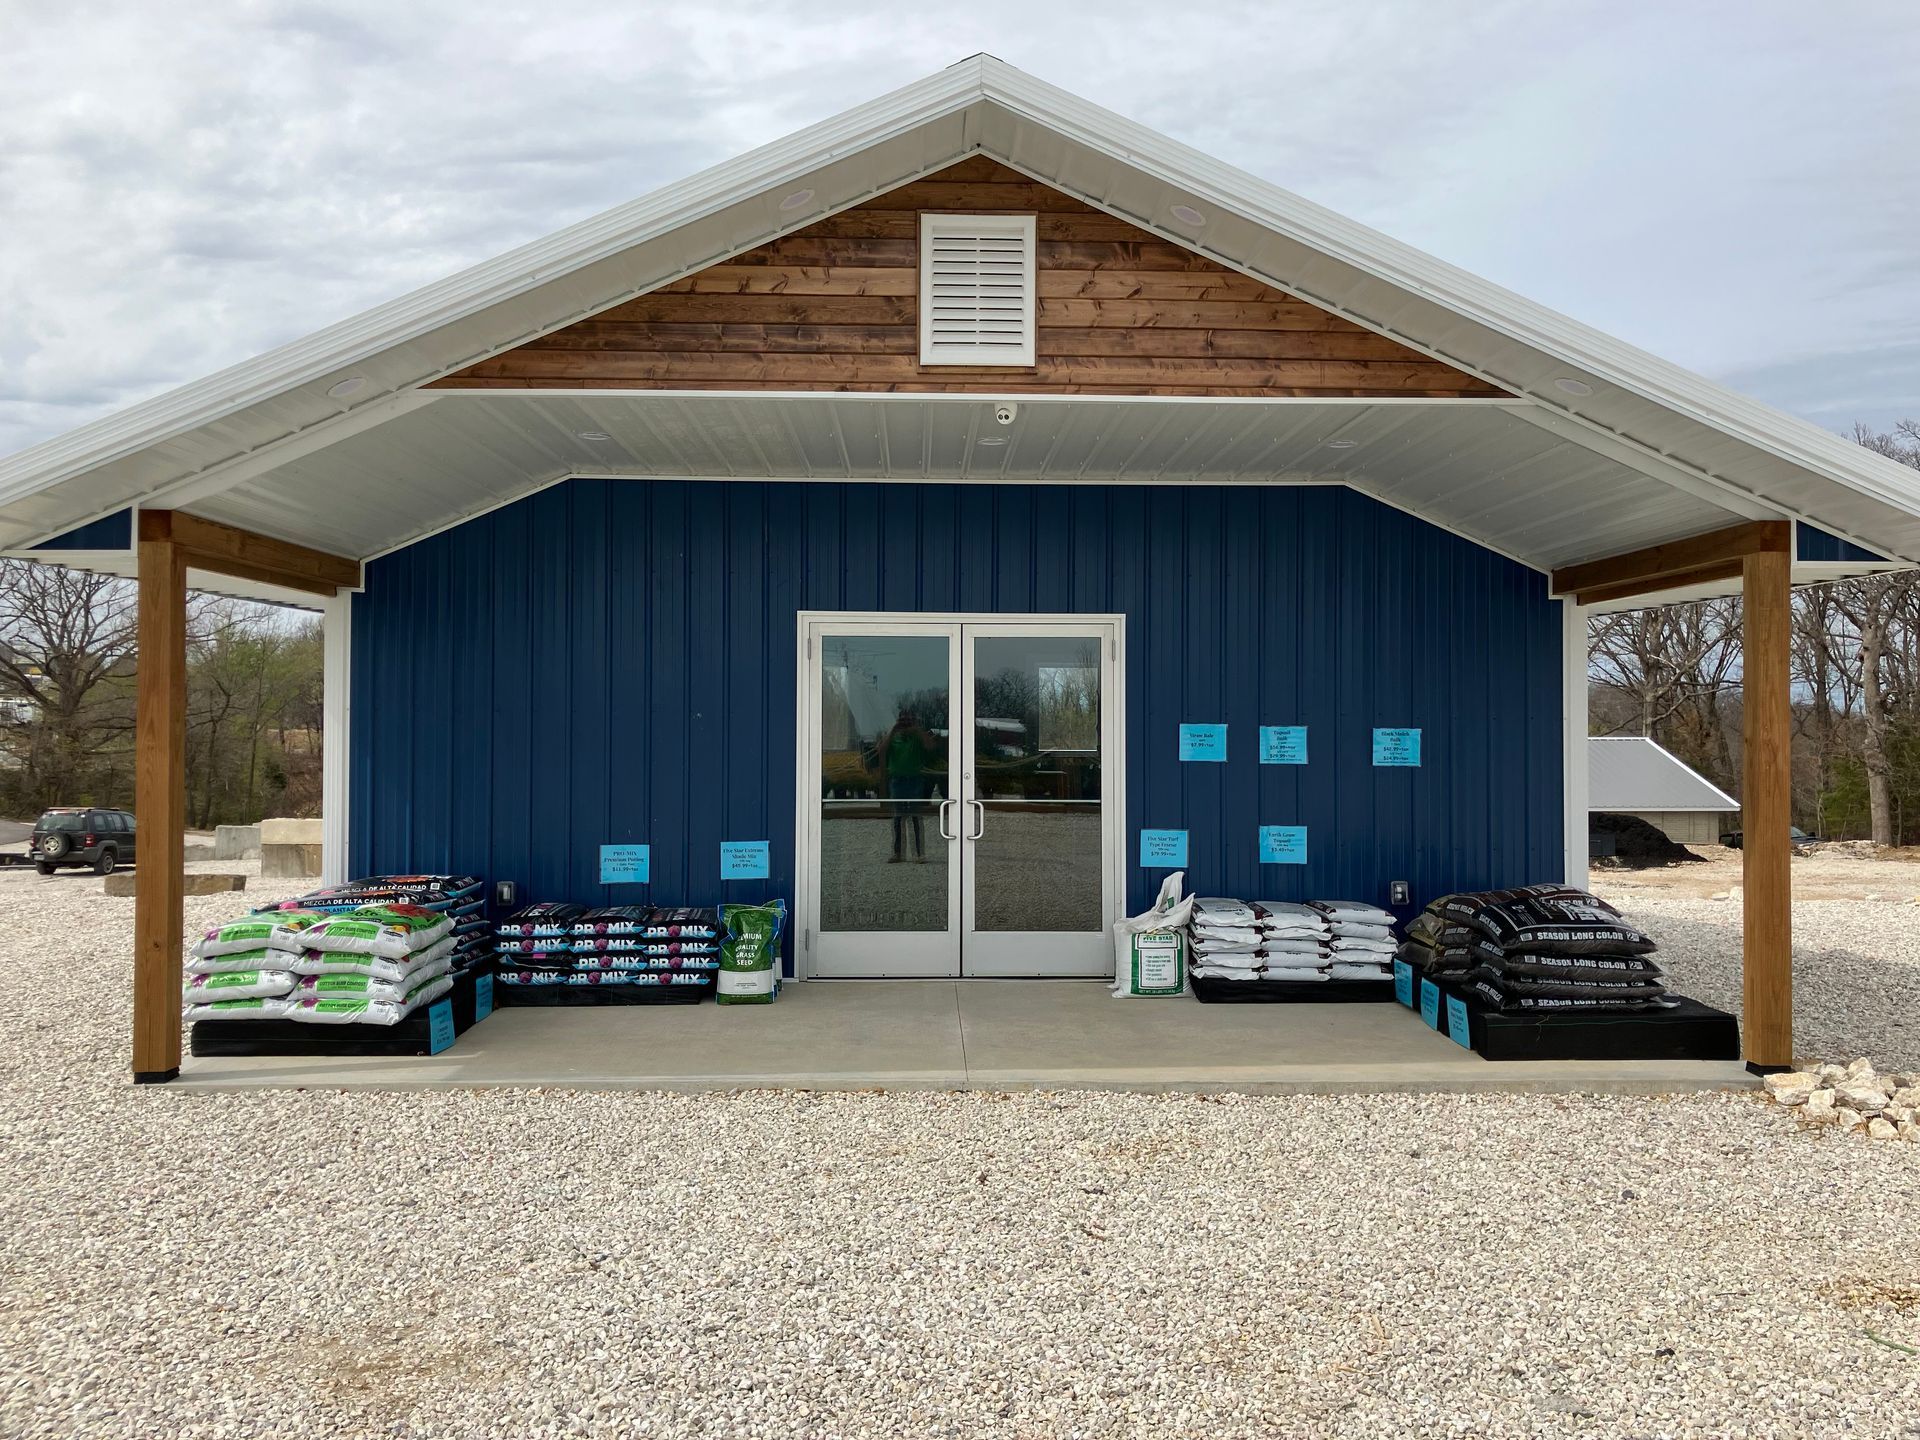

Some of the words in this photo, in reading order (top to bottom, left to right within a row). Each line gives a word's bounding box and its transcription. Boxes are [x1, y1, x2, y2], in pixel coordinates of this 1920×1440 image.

[1537, 932, 1569, 940] SEASON
[1571, 932, 1594, 940] LONG
[1596, 932, 1623, 940] COLOR
[735, 944, 758, 952] QUALITY
[1541, 957, 1573, 967] SEASON
[1573, 958, 1597, 968] LONG
[1598, 960, 1626, 970] COLOR
